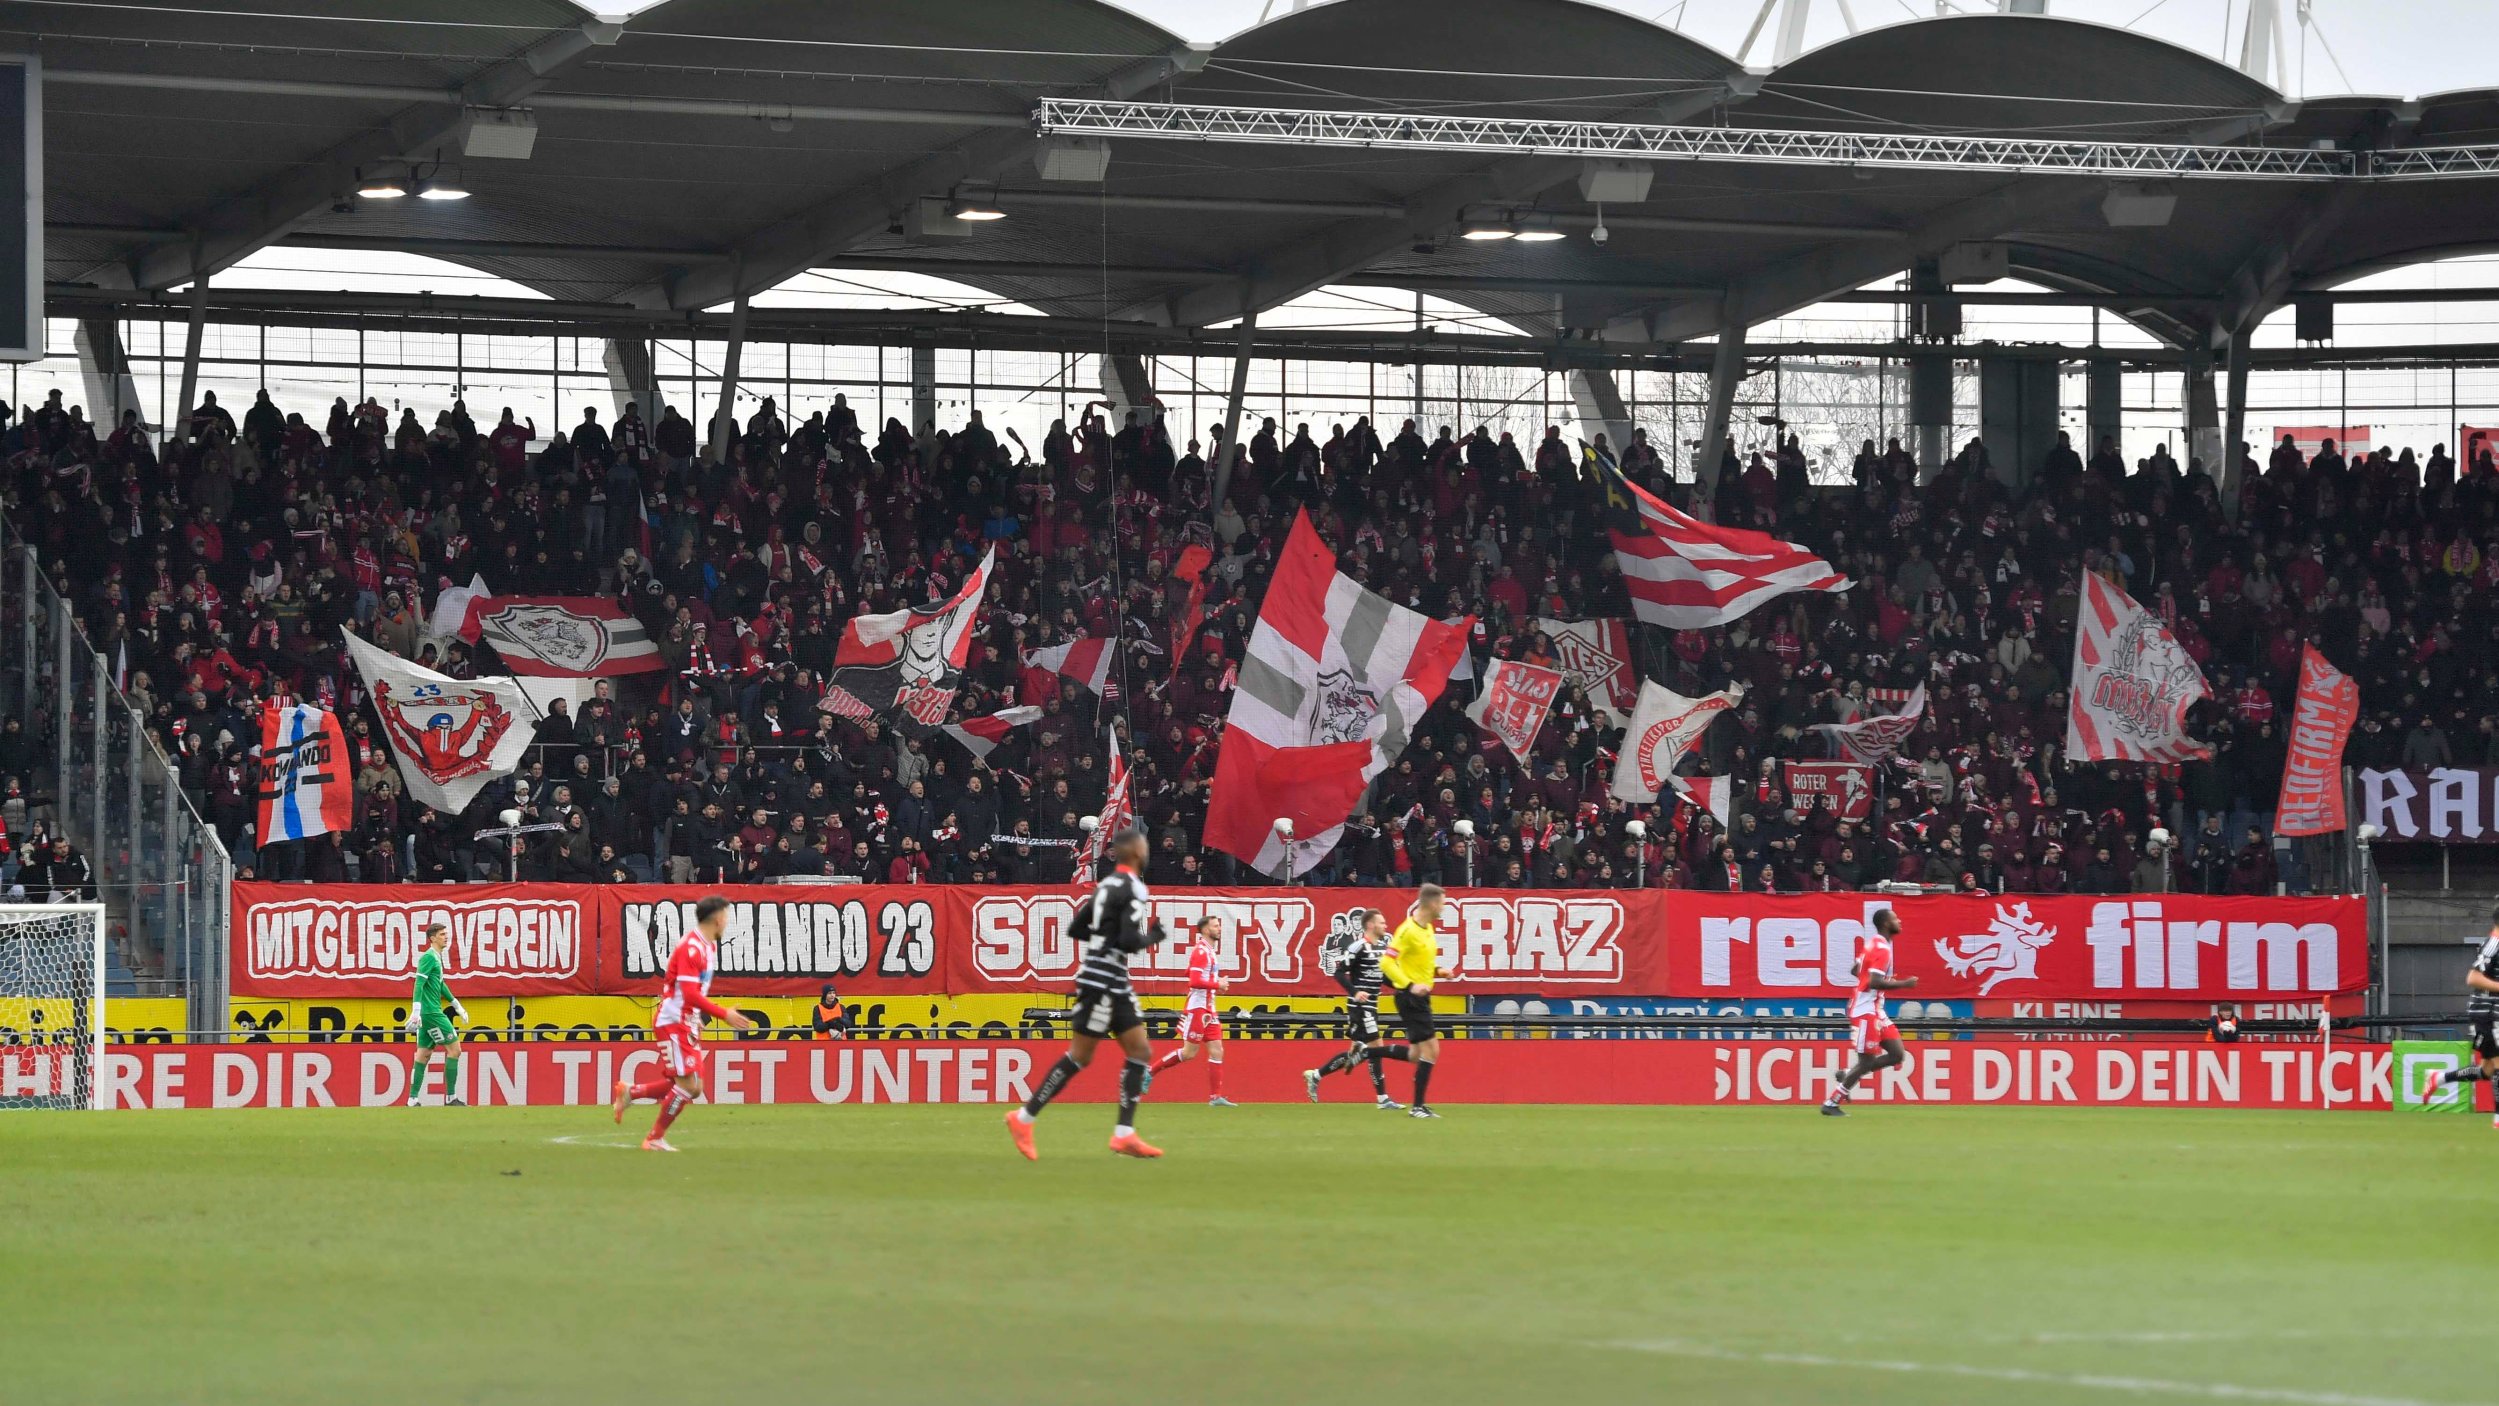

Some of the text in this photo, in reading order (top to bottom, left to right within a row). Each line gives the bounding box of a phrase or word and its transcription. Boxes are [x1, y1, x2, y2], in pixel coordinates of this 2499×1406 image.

[410, 684, 441, 696] 23
[1792, 773, 1827, 790] ROTER
[2358, 767, 2499, 838] RA
[880, 901, 935, 976] 23
[979, 902, 1304, 970] SOETY
[1701, 901, 2338, 990] red firm
[213, 1052, 336, 1107] DIR
[360, 1051, 527, 1106] DEIN
[810, 1048, 1032, 1103] UNTER
[1974, 1049, 2078, 1101] DIR
[2097, 1049, 2240, 1102] DEIN
[2261, 1050, 2393, 1103] TICK
